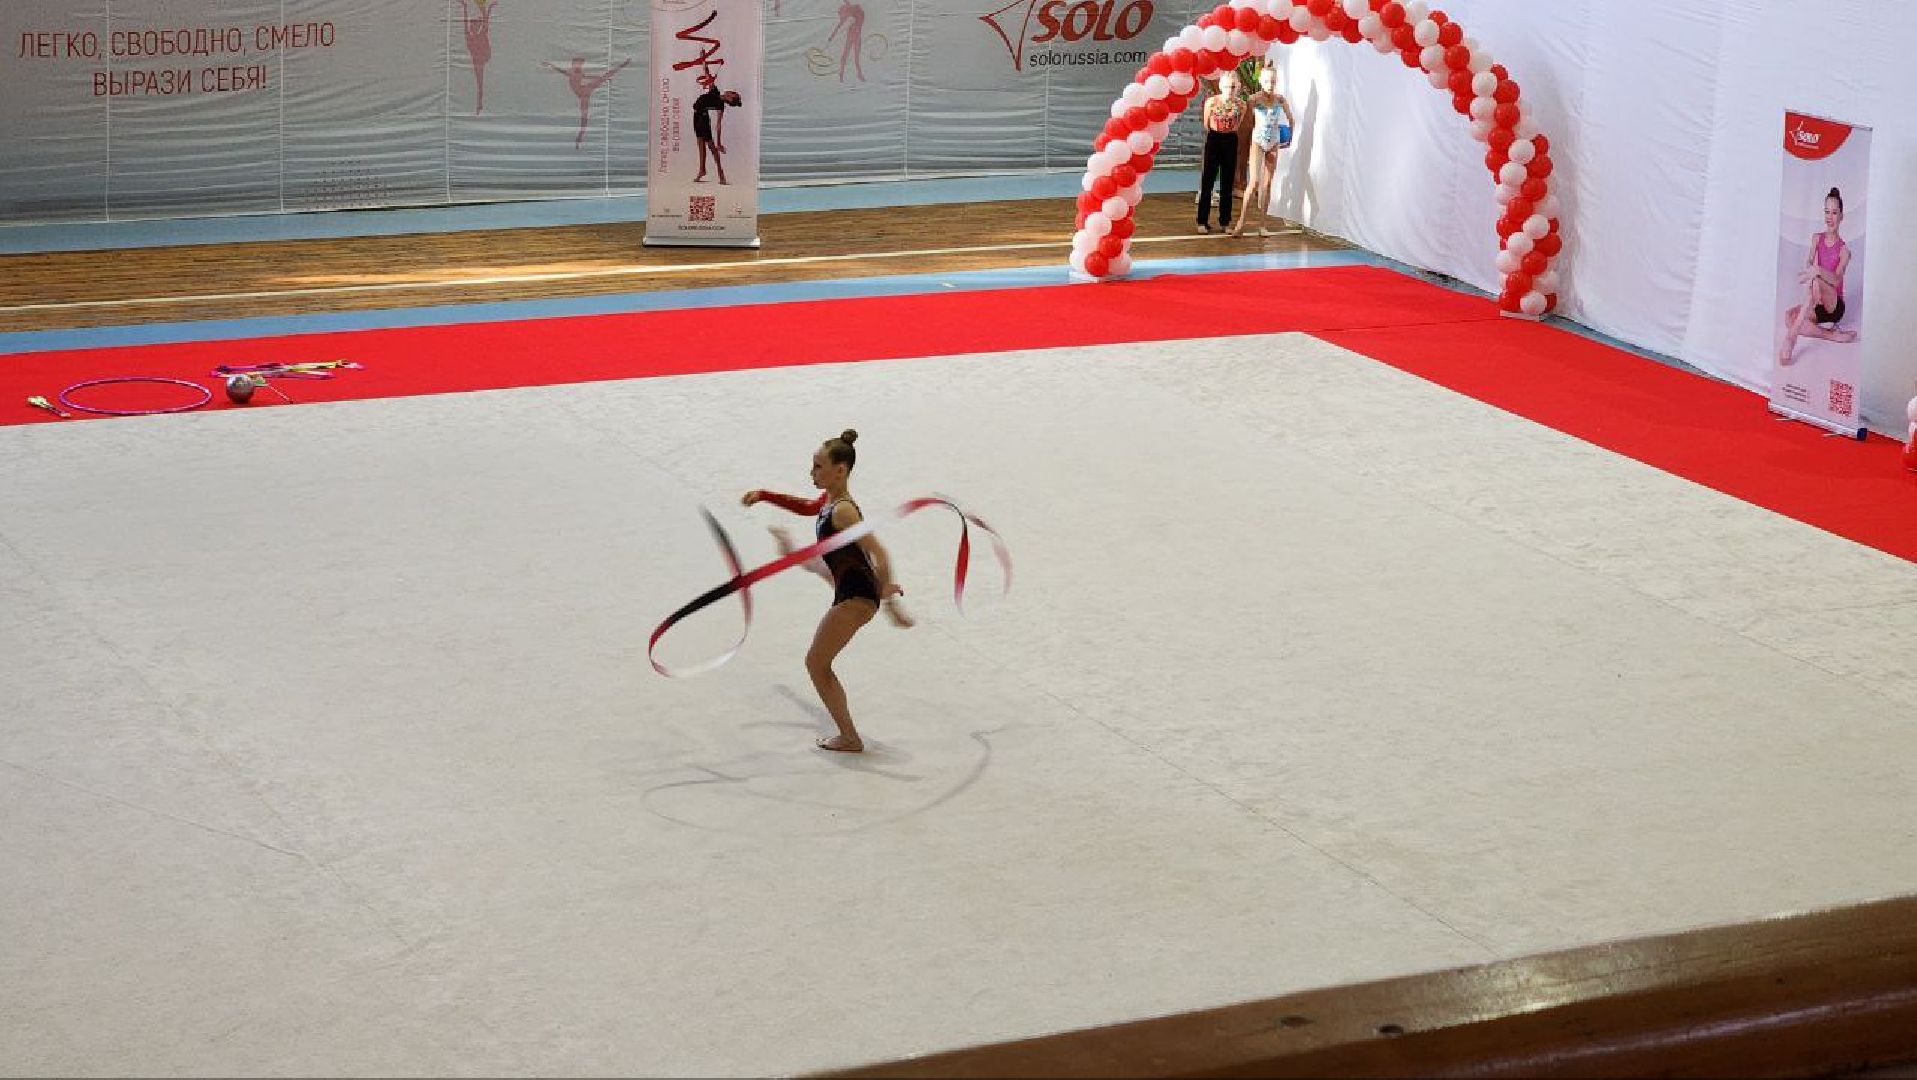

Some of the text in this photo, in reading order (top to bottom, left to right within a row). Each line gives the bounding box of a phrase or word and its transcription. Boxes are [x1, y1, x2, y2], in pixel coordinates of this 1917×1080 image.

[1031, 0, 1154, 43] SOLO
[19, 22, 335, 59] ЛЕГКО, СВОБОДНО, СМЕЛО
[1030, 49, 1147, 67] solorussia.com
[94, 65, 267, 96] ВЫРАЗИ СЕБЯ!
